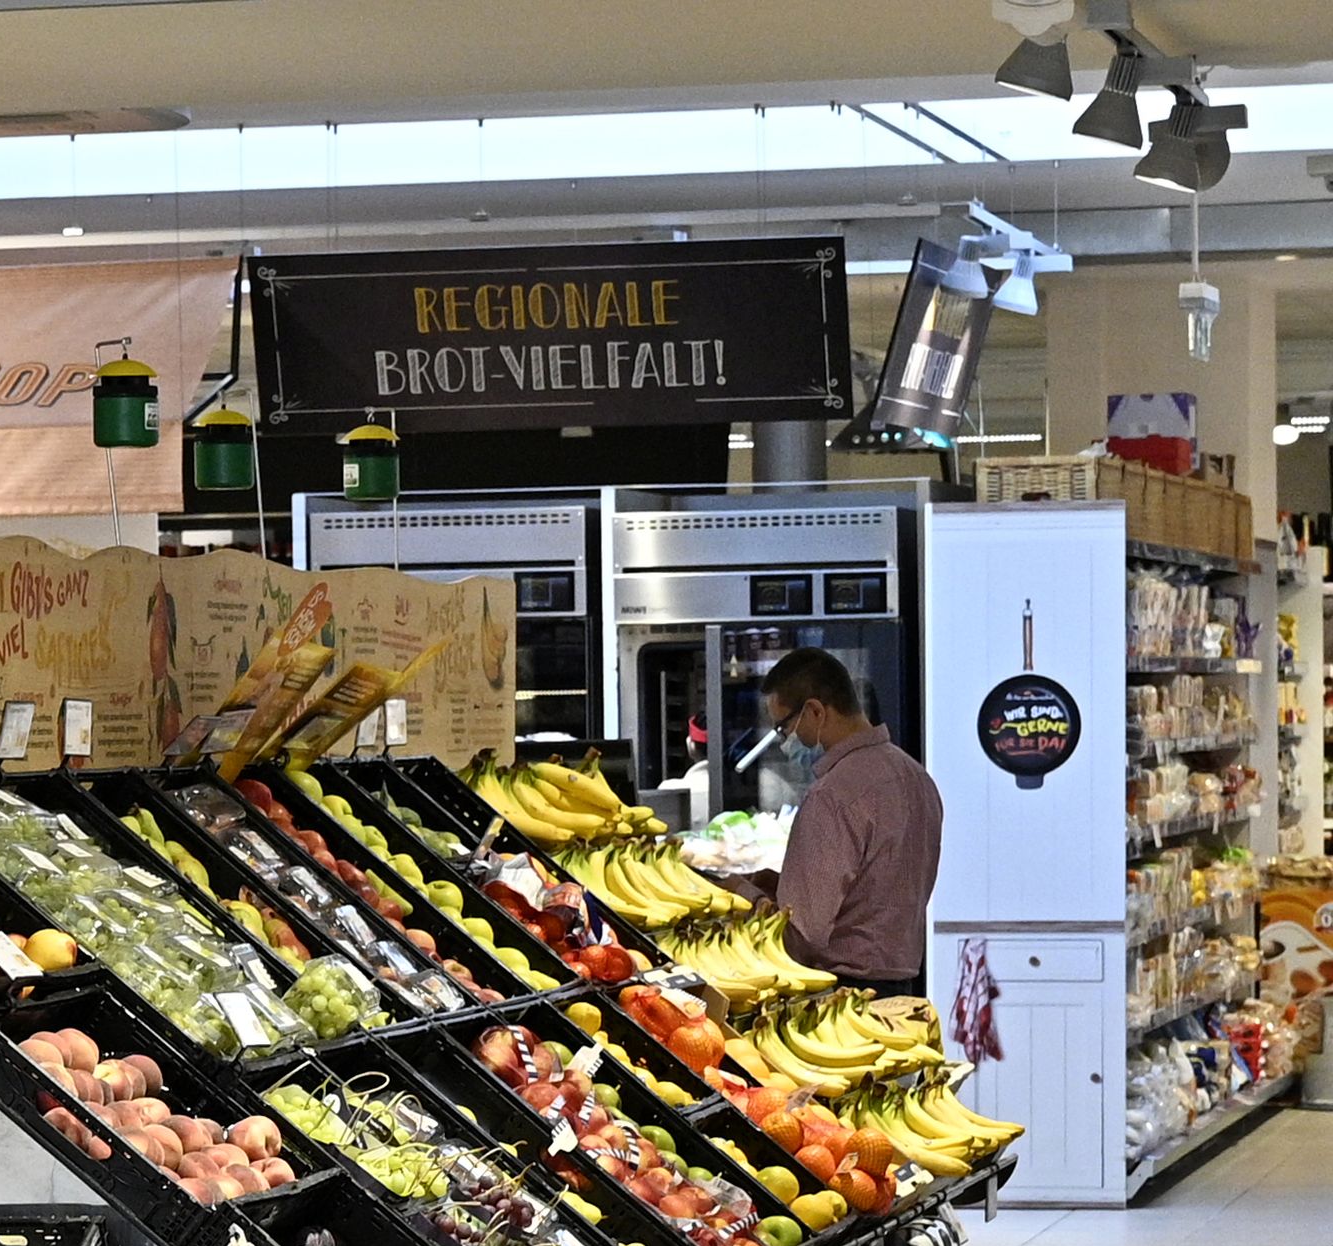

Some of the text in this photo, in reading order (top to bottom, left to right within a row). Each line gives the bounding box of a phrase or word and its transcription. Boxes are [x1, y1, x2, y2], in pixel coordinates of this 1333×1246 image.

[413, 279, 681, 334] REGIONALE
[373, 339, 728, 396] BROT-VIELFALT!
[56, 569, 89, 608] GANZ
[1004, 705, 1062, 721] WIR SIND
[1017, 718, 1068, 736] GERNE
